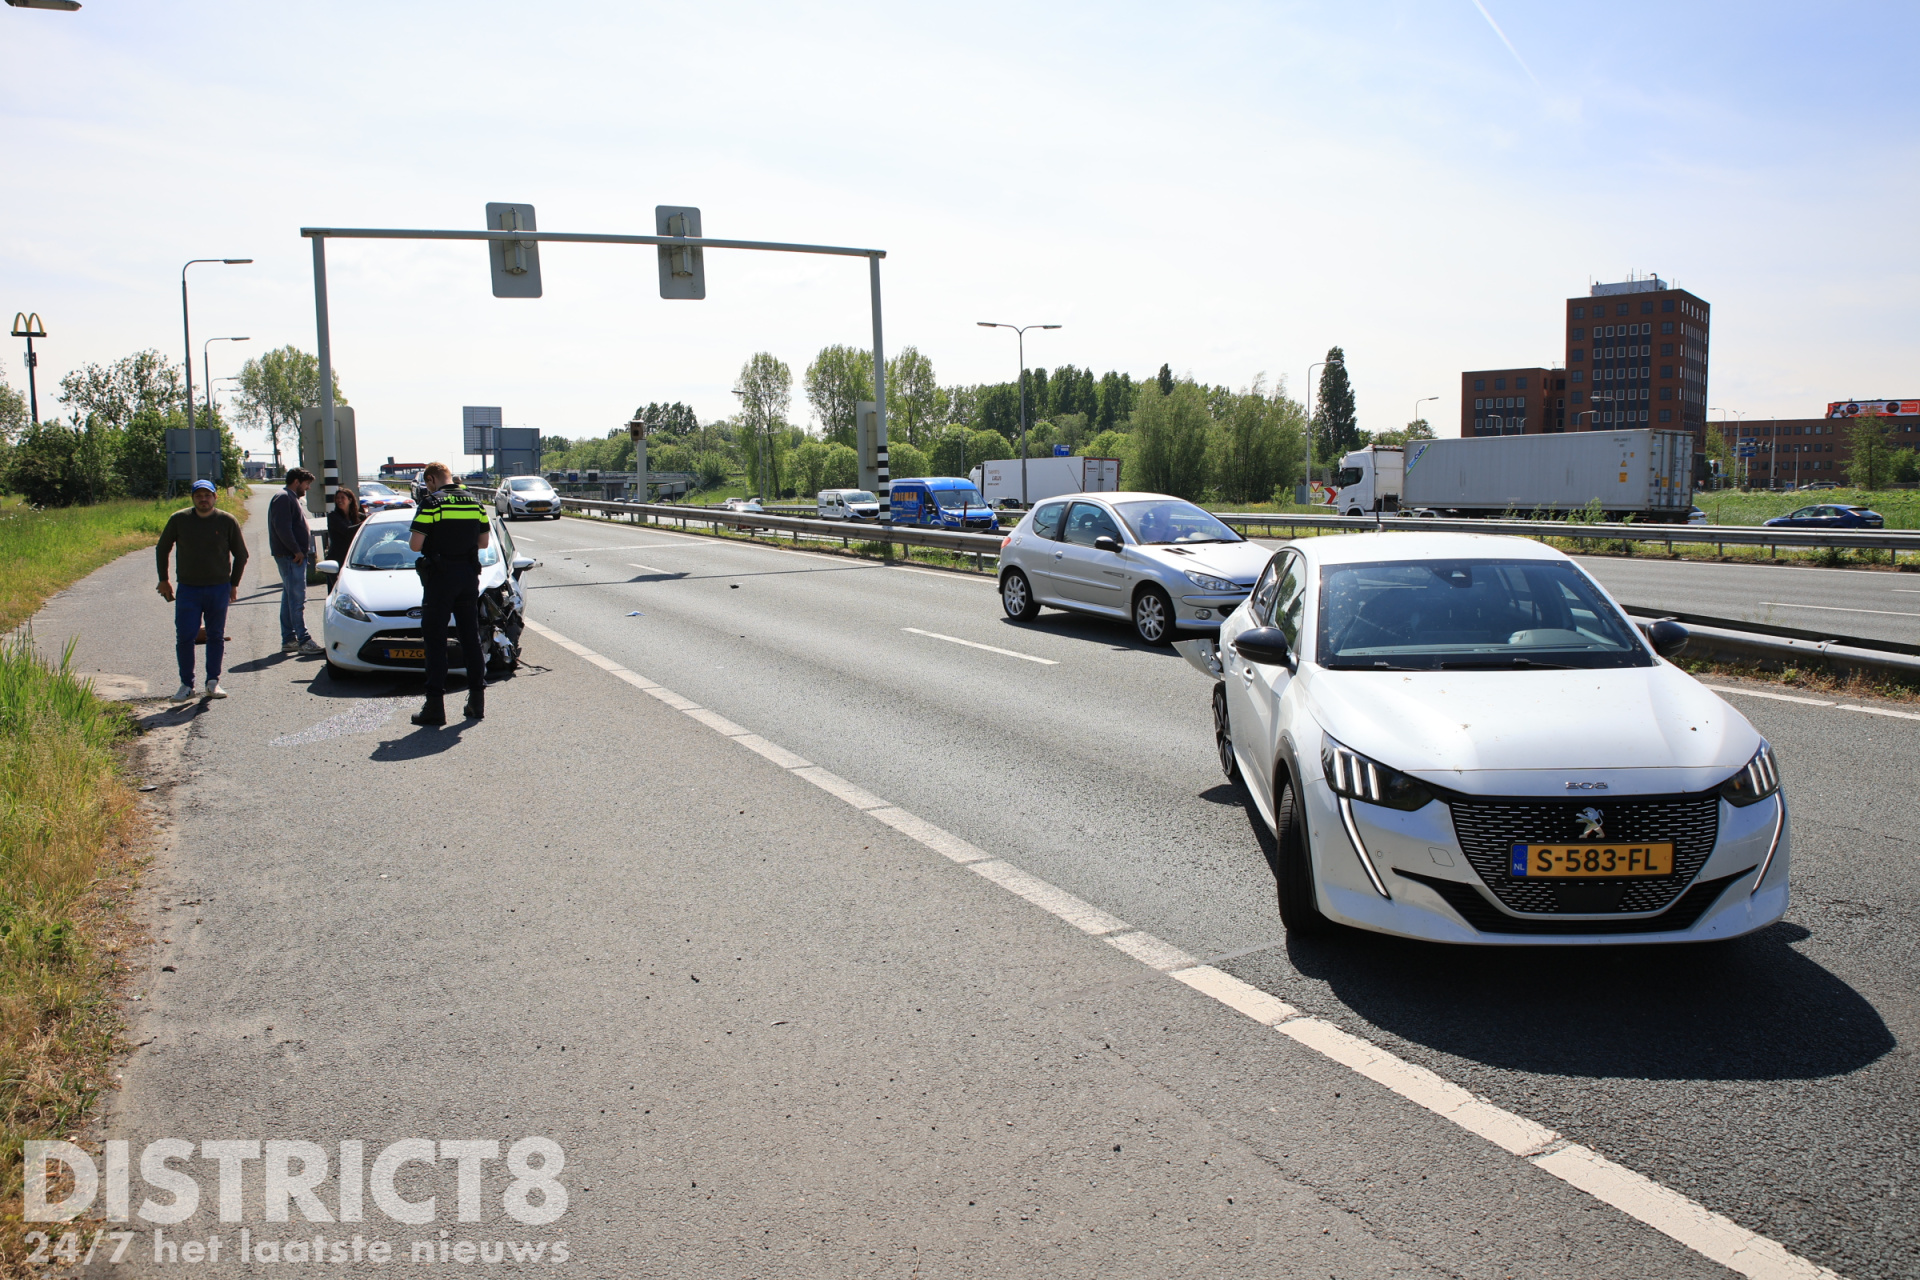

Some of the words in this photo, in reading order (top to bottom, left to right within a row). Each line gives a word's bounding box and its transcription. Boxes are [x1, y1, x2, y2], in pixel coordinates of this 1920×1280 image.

[394, 649, 426, 658] 71-ZG
[1565, 781, 1609, 790] 208
[1513, 863, 1525, 871] NL
[1536, 848, 1658, 872] S-583-FL
